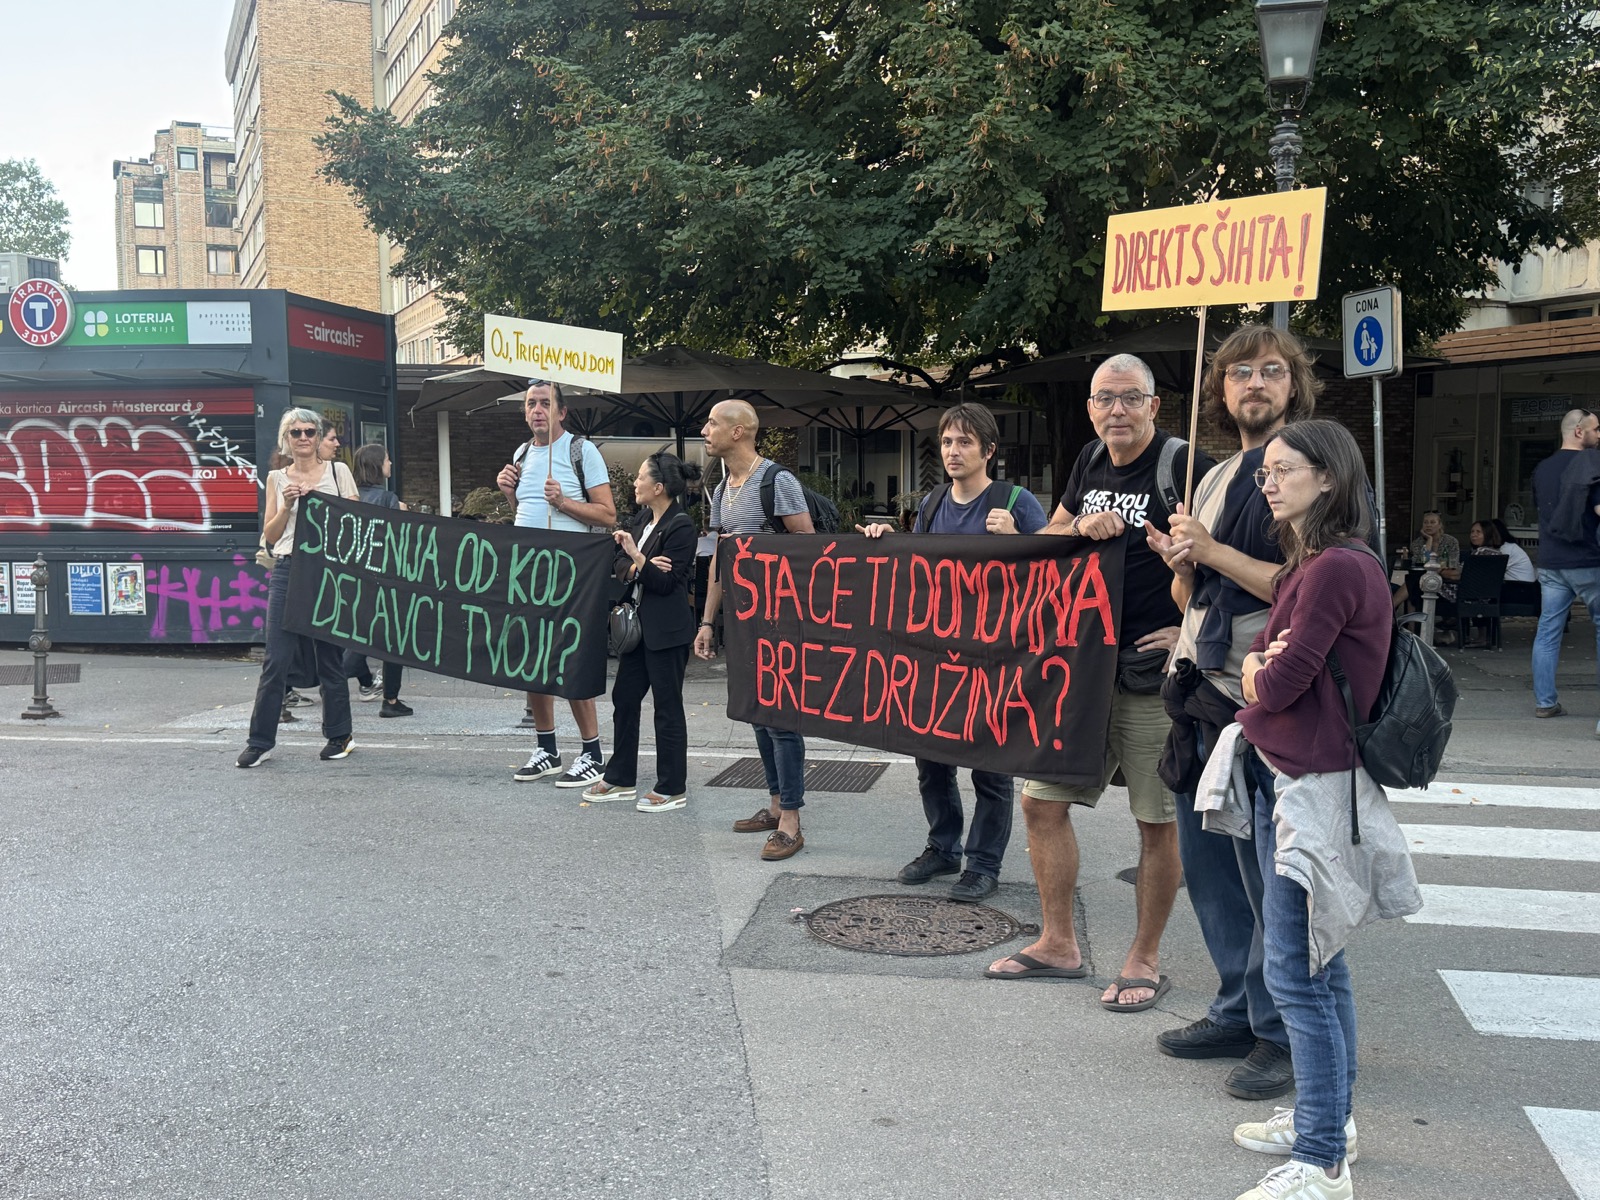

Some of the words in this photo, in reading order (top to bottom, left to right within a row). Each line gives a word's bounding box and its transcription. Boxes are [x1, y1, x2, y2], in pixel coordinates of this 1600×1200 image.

[1209, 206, 1312, 298] ŠIHTA!
[12, 282, 63, 307] TRAFIKA
[1355, 297, 1379, 313] CONA
[29, 302, 48, 327] T
[115, 313, 174, 324] LOTERIJA
[21, 329, 58, 343] 3DVA
[115, 325, 175, 333] SLOVENIJE
[314, 321, 355, 347] aircash
[564, 349, 587, 372] MOJ
[588, 354, 614, 375] DOM
[16, 402, 51, 414] kartica
[57, 401, 106, 413] Aircash
[1113, 492, 1150, 510] YOU
[299, 497, 447, 591] SLOVENIJA,
[454, 532, 498, 594] OD
[507, 543, 576, 607] KOD
[71, 565, 101, 575] DELO
[733, 536, 803, 621] ŠTA
[808, 541, 857, 630] ĆE
[866, 556, 898, 631] TI
[905, 551, 1117, 655] DOMOVINA
[311, 567, 443, 668] DELAVCI
[461, 603, 582, 686] TVOJI?
[756, 637, 857, 723] BREZ
[862, 649, 1071, 751] DRUŽINA?
